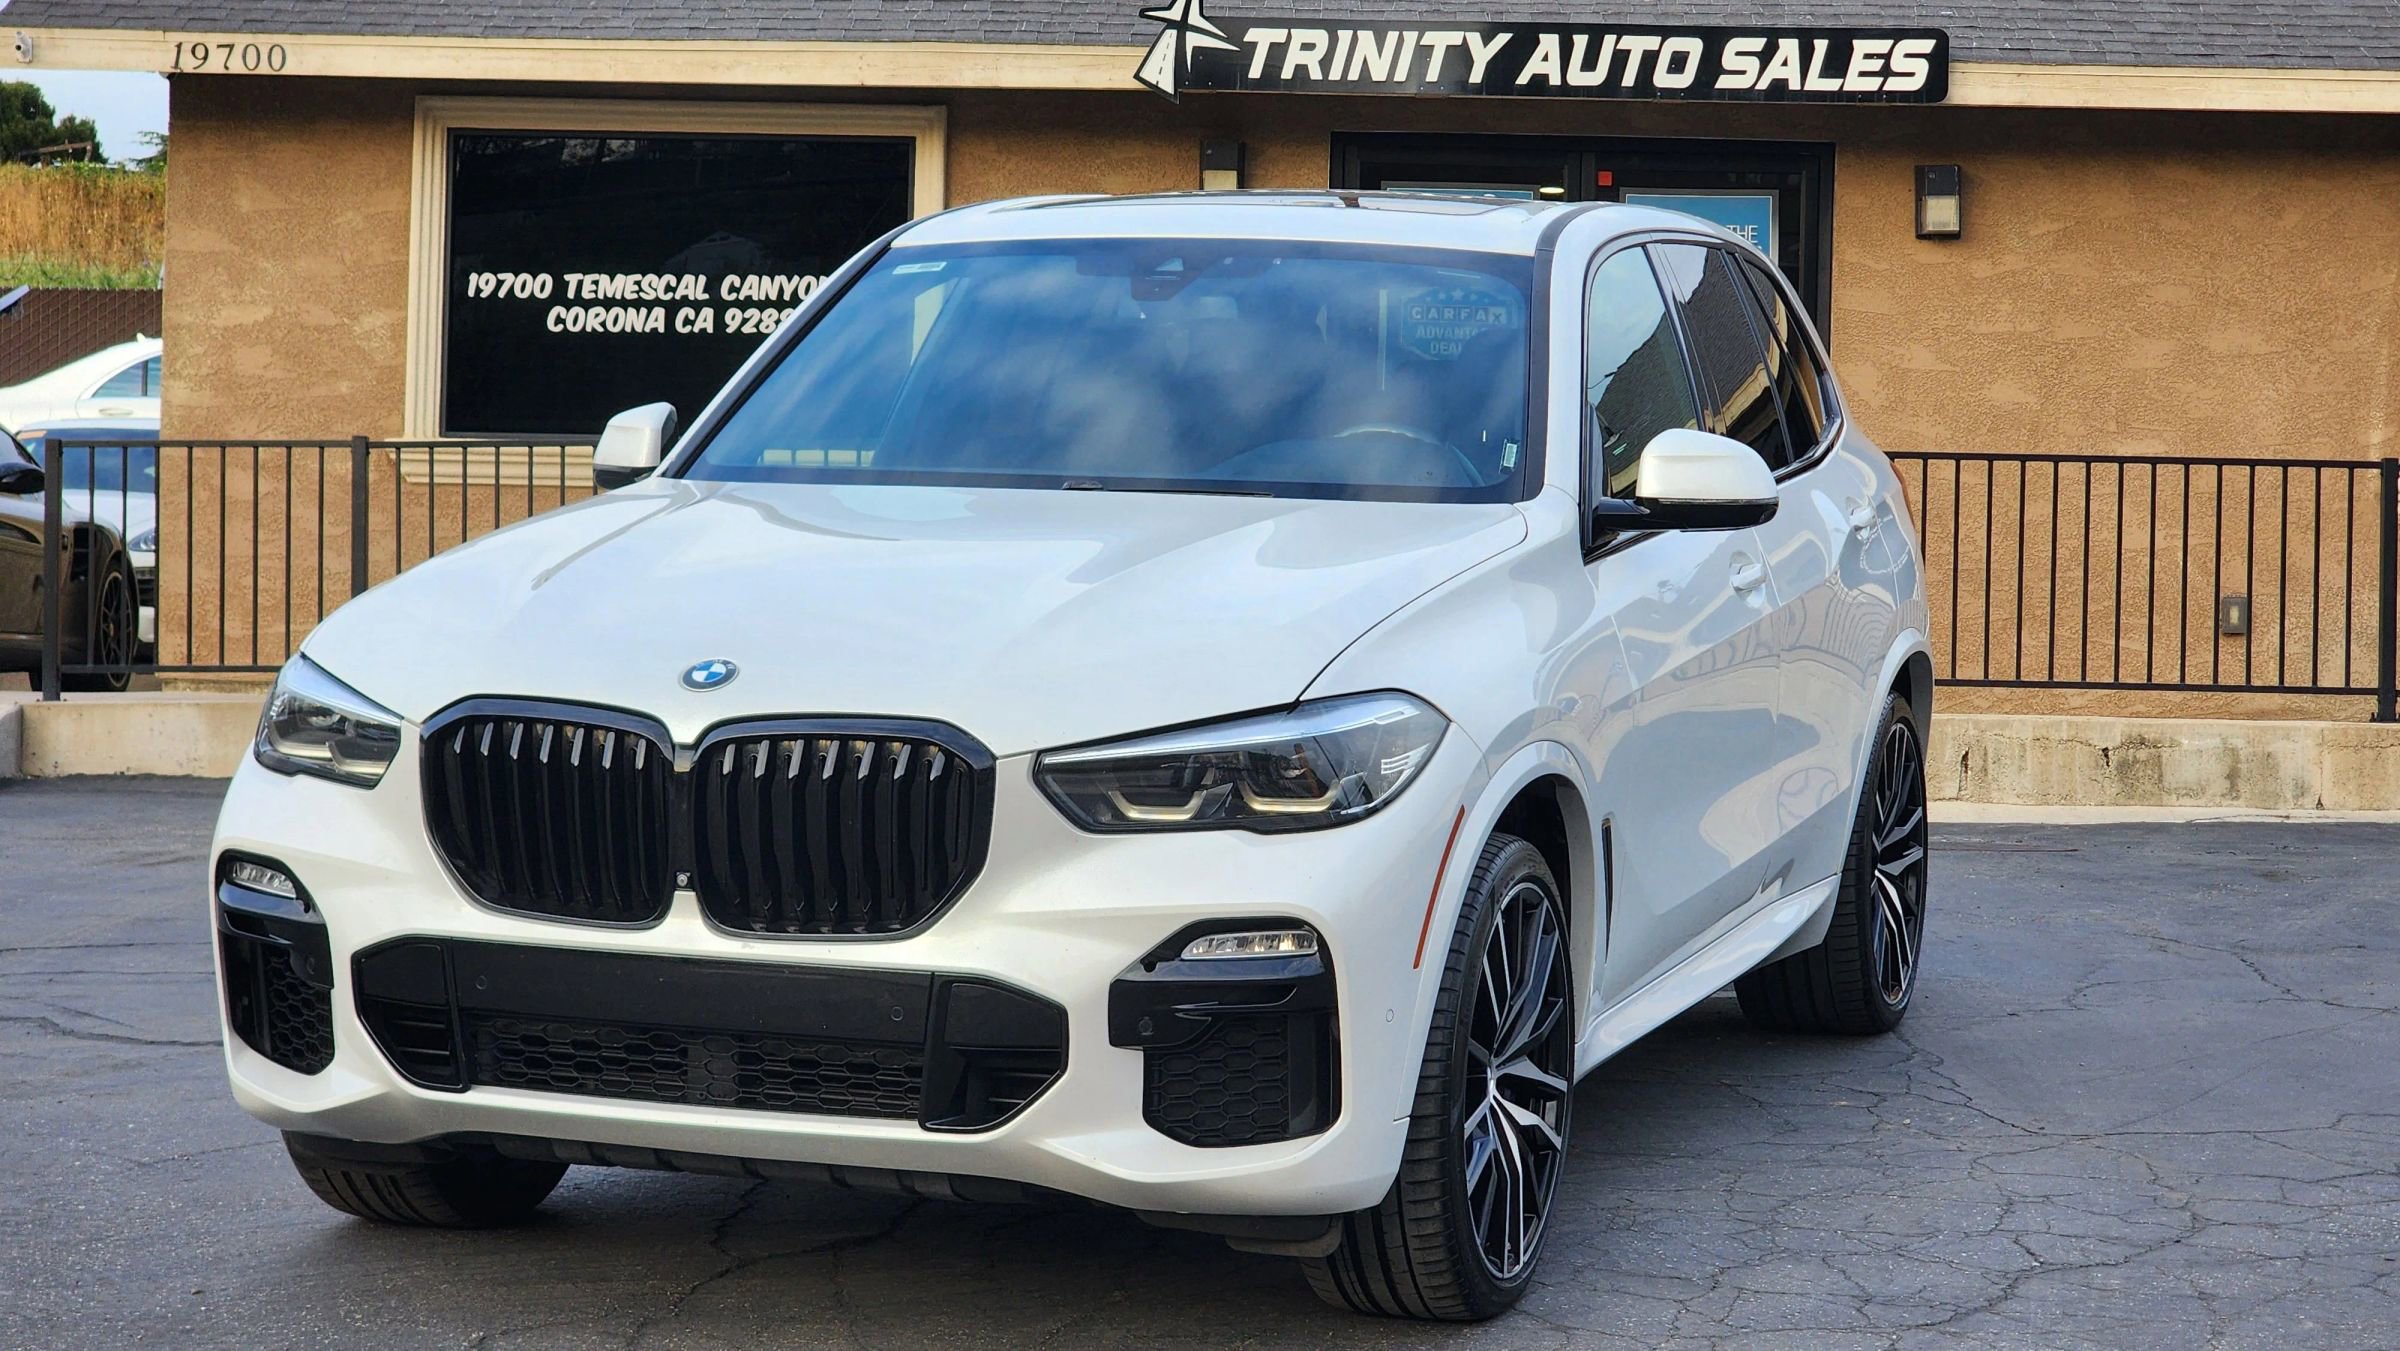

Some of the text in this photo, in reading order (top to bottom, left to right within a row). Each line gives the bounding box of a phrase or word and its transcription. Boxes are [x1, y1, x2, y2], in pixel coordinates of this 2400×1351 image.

[171, 41, 286, 72] 19700
[1242, 28, 1937, 92] TRINITY AUTO SALES
[467, 272, 828, 301] 19700 TEMESCAL CANYO
[546, 305, 666, 334] CORONA
[674, 306, 715, 334] CA
[1411, 306, 1504, 324] CARFAX
[1430, 341, 1462, 355] DEA
